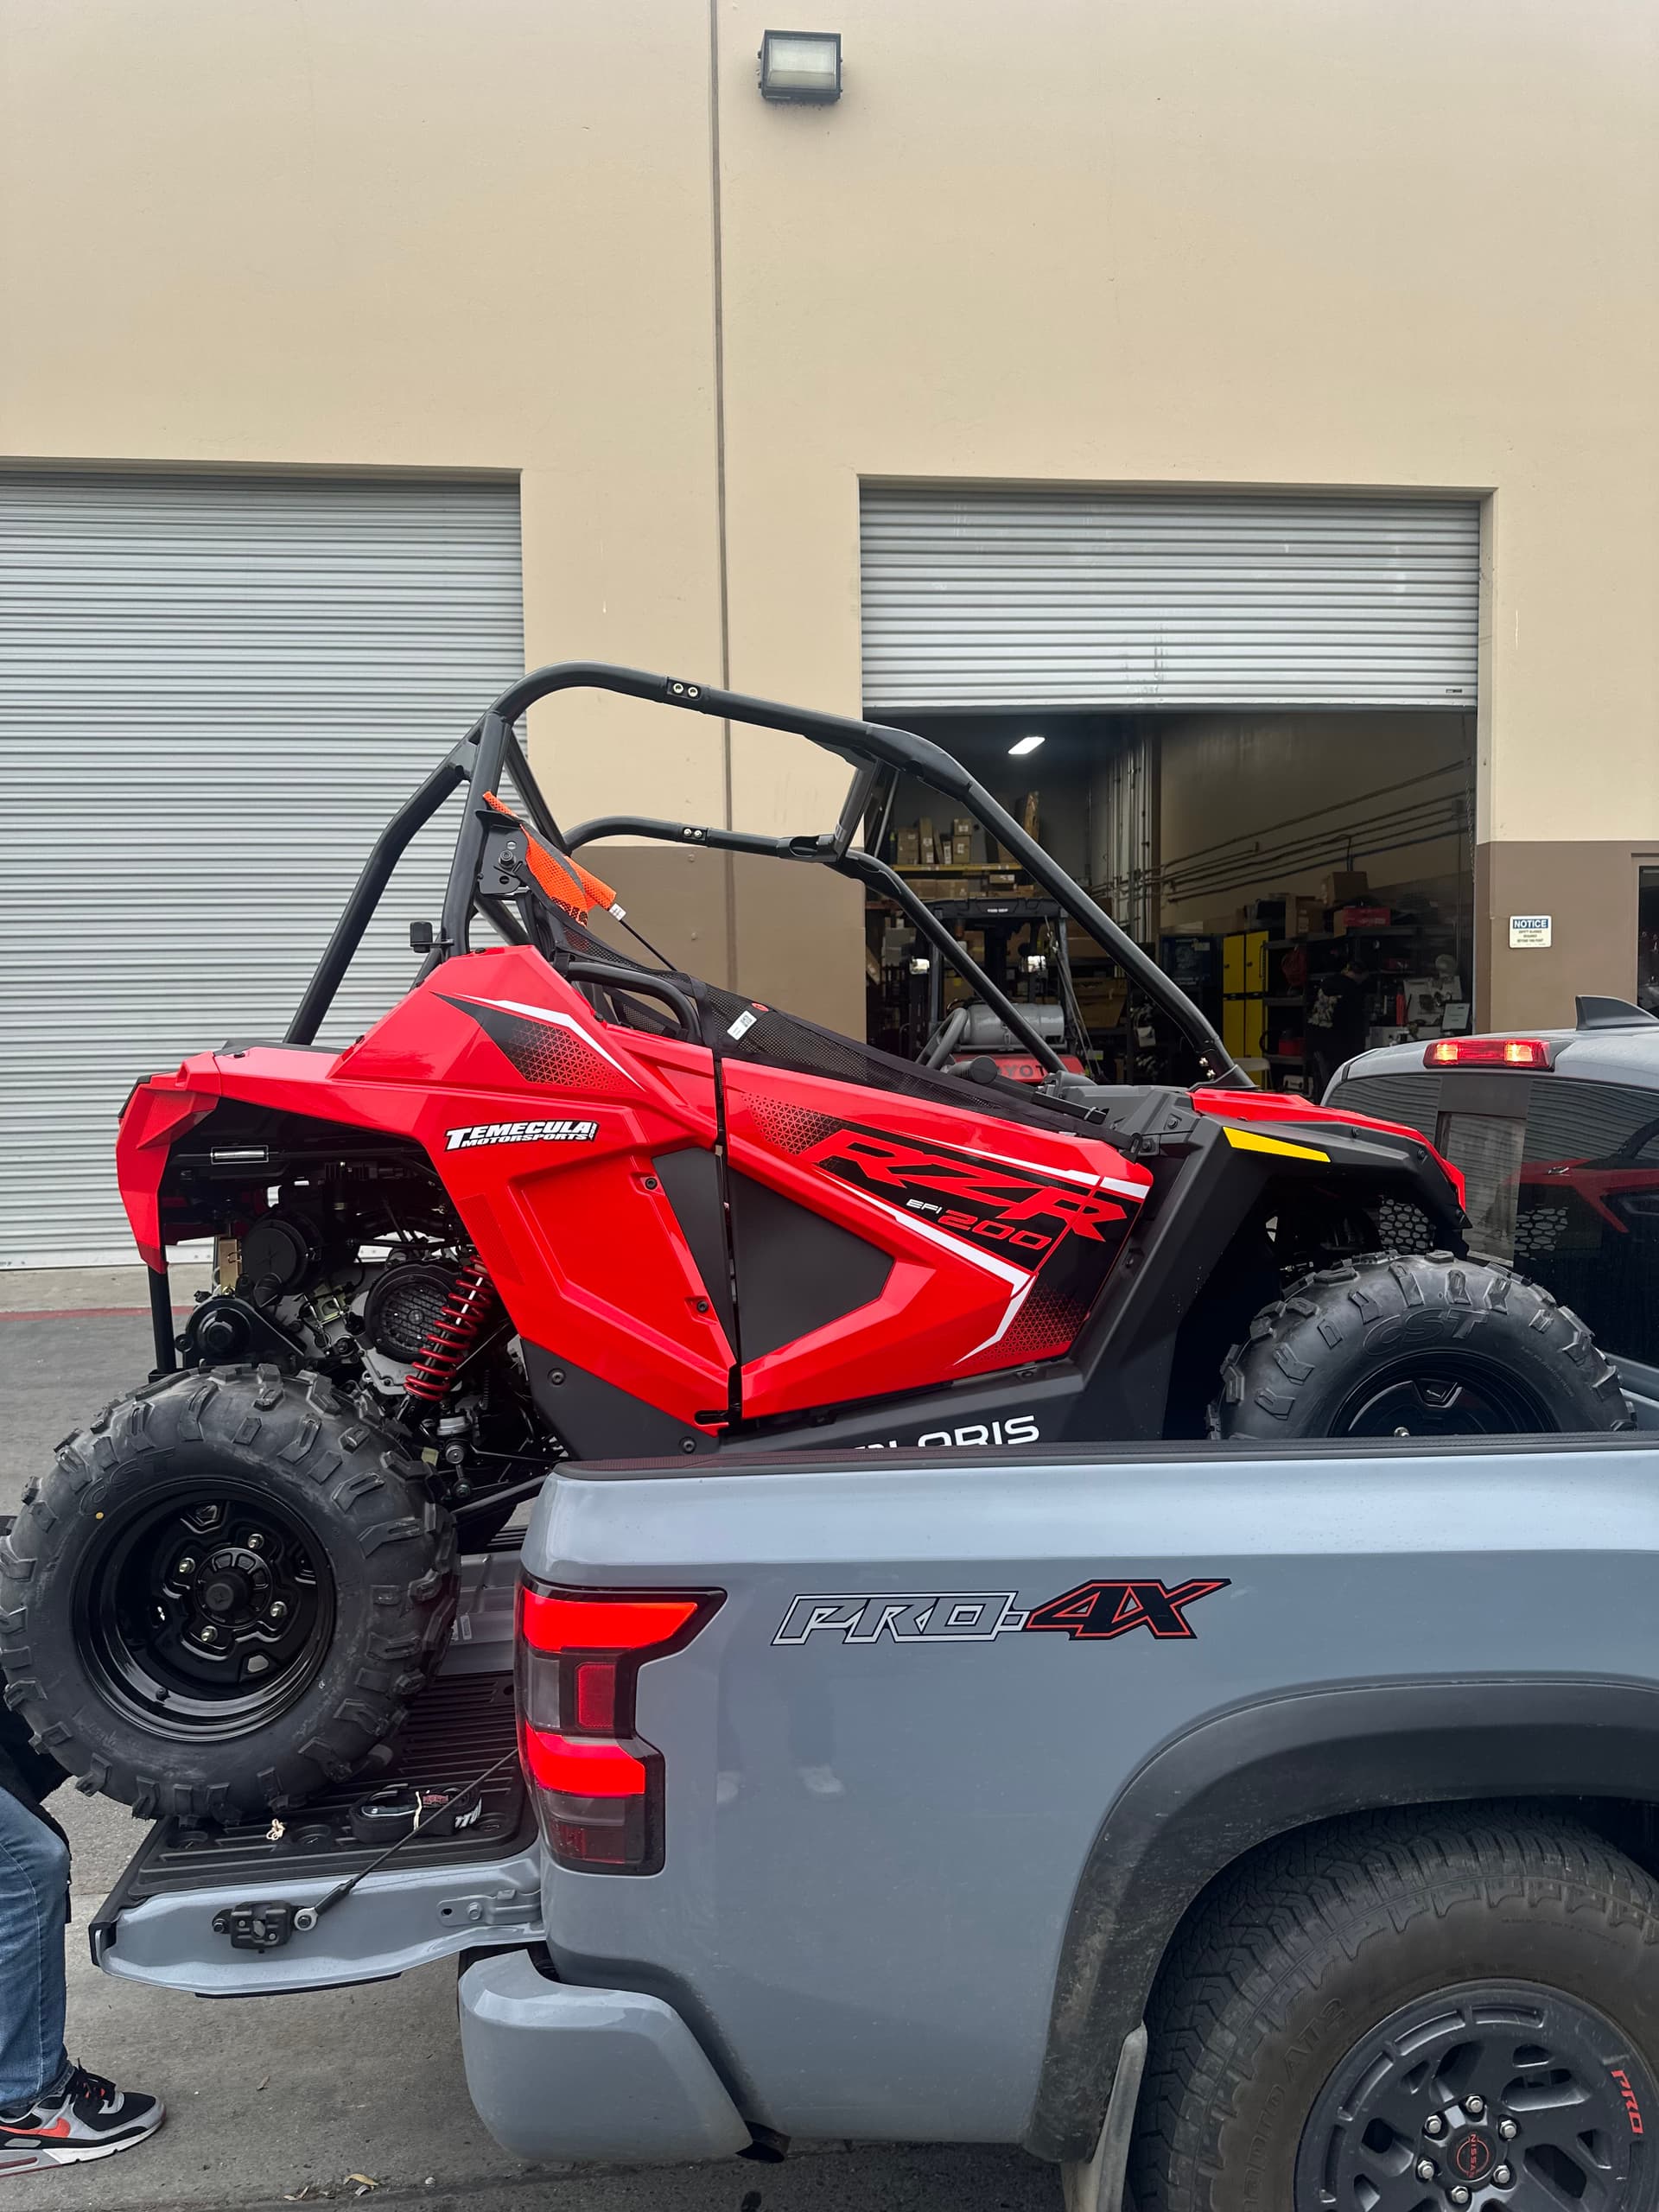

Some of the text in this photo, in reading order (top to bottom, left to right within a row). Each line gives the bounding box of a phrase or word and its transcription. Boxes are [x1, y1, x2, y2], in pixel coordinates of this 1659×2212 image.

[1514, 919, 1548, 928] NOTICE
[1000, 1064, 1045, 1077] YOT
[446, 1121, 593, 1150] TEMECULA
[461, 1134, 589, 1147] MOTORSPORTS
[799, 1128, 1127, 1243] RZR
[906, 1198, 1052, 1250] EFI 200
[1363, 1307, 1490, 1356] CST
[1611, 2069, 1644, 2134] PRO
[1468, 2134, 1478, 2178] NISSAN
